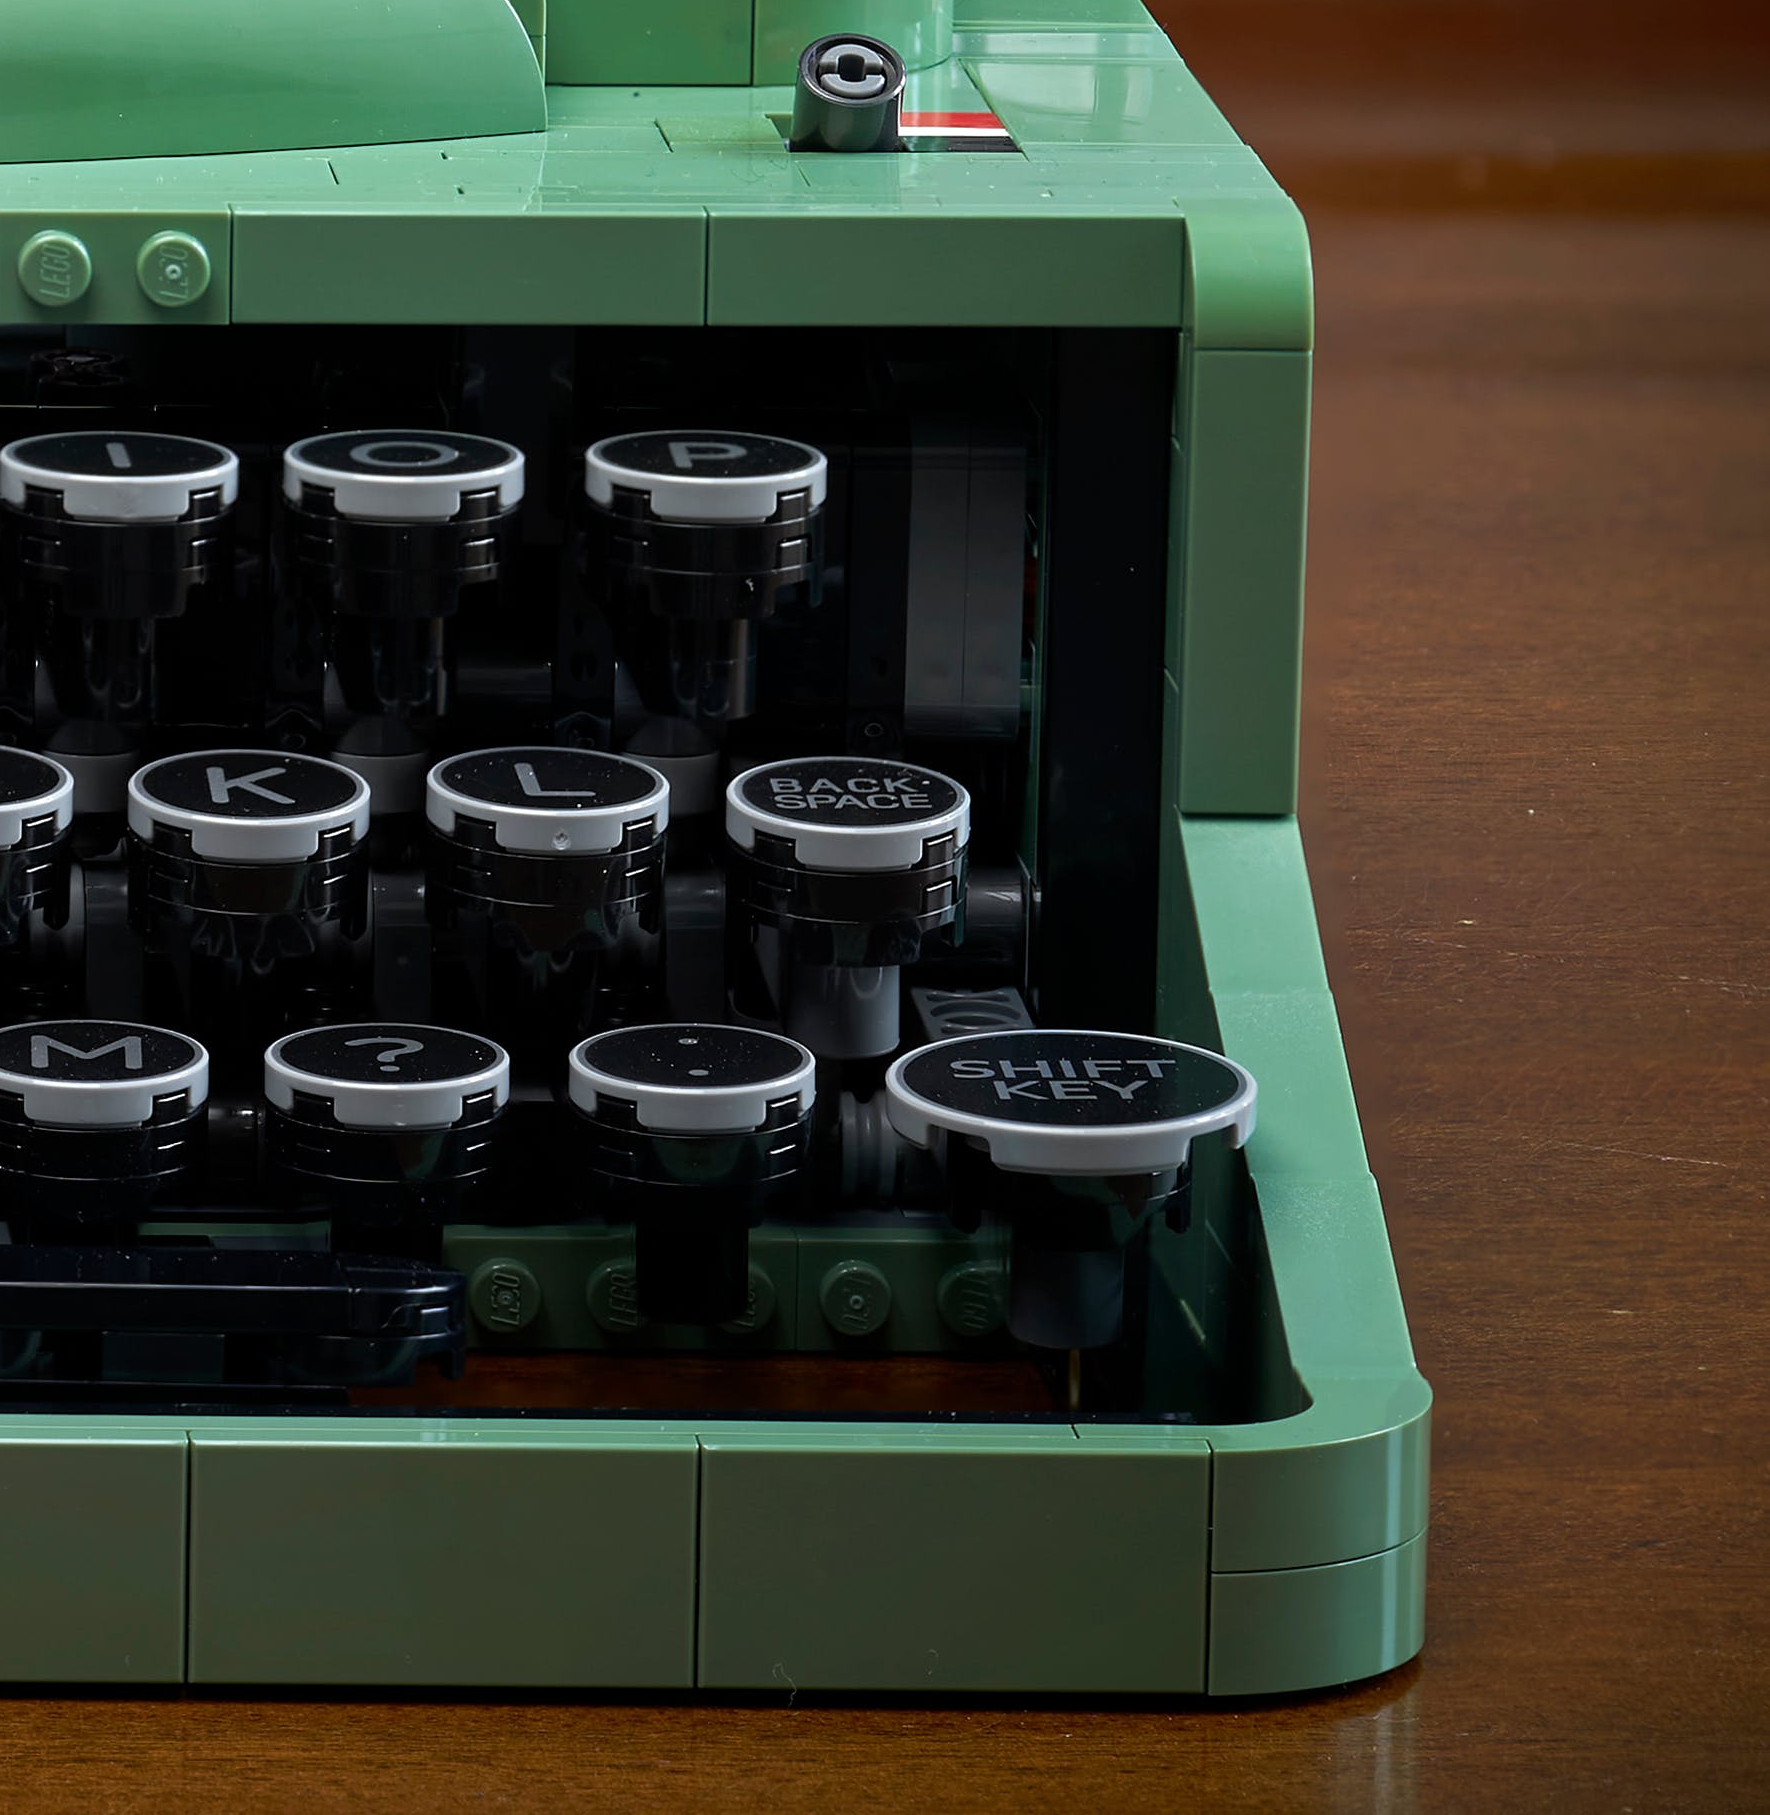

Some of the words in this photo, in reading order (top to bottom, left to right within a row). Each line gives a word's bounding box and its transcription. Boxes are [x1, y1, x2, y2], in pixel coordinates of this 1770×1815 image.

[39, 244, 71, 299] LEGO
[106, 443, 131, 468] I
[349, 440, 460, 468] O
[669, 442, 747, 468] P
[207, 767, 295, 804] K
[514, 763, 596, 796] L
[774, 794, 932, 809] SPACE
[31, 1035, 142, 1069] M
[345, 1036, 423, 1071] ?
[950, 1057, 1176, 1078] SHIFT
[993, 1081, 1147, 1099] KEY
